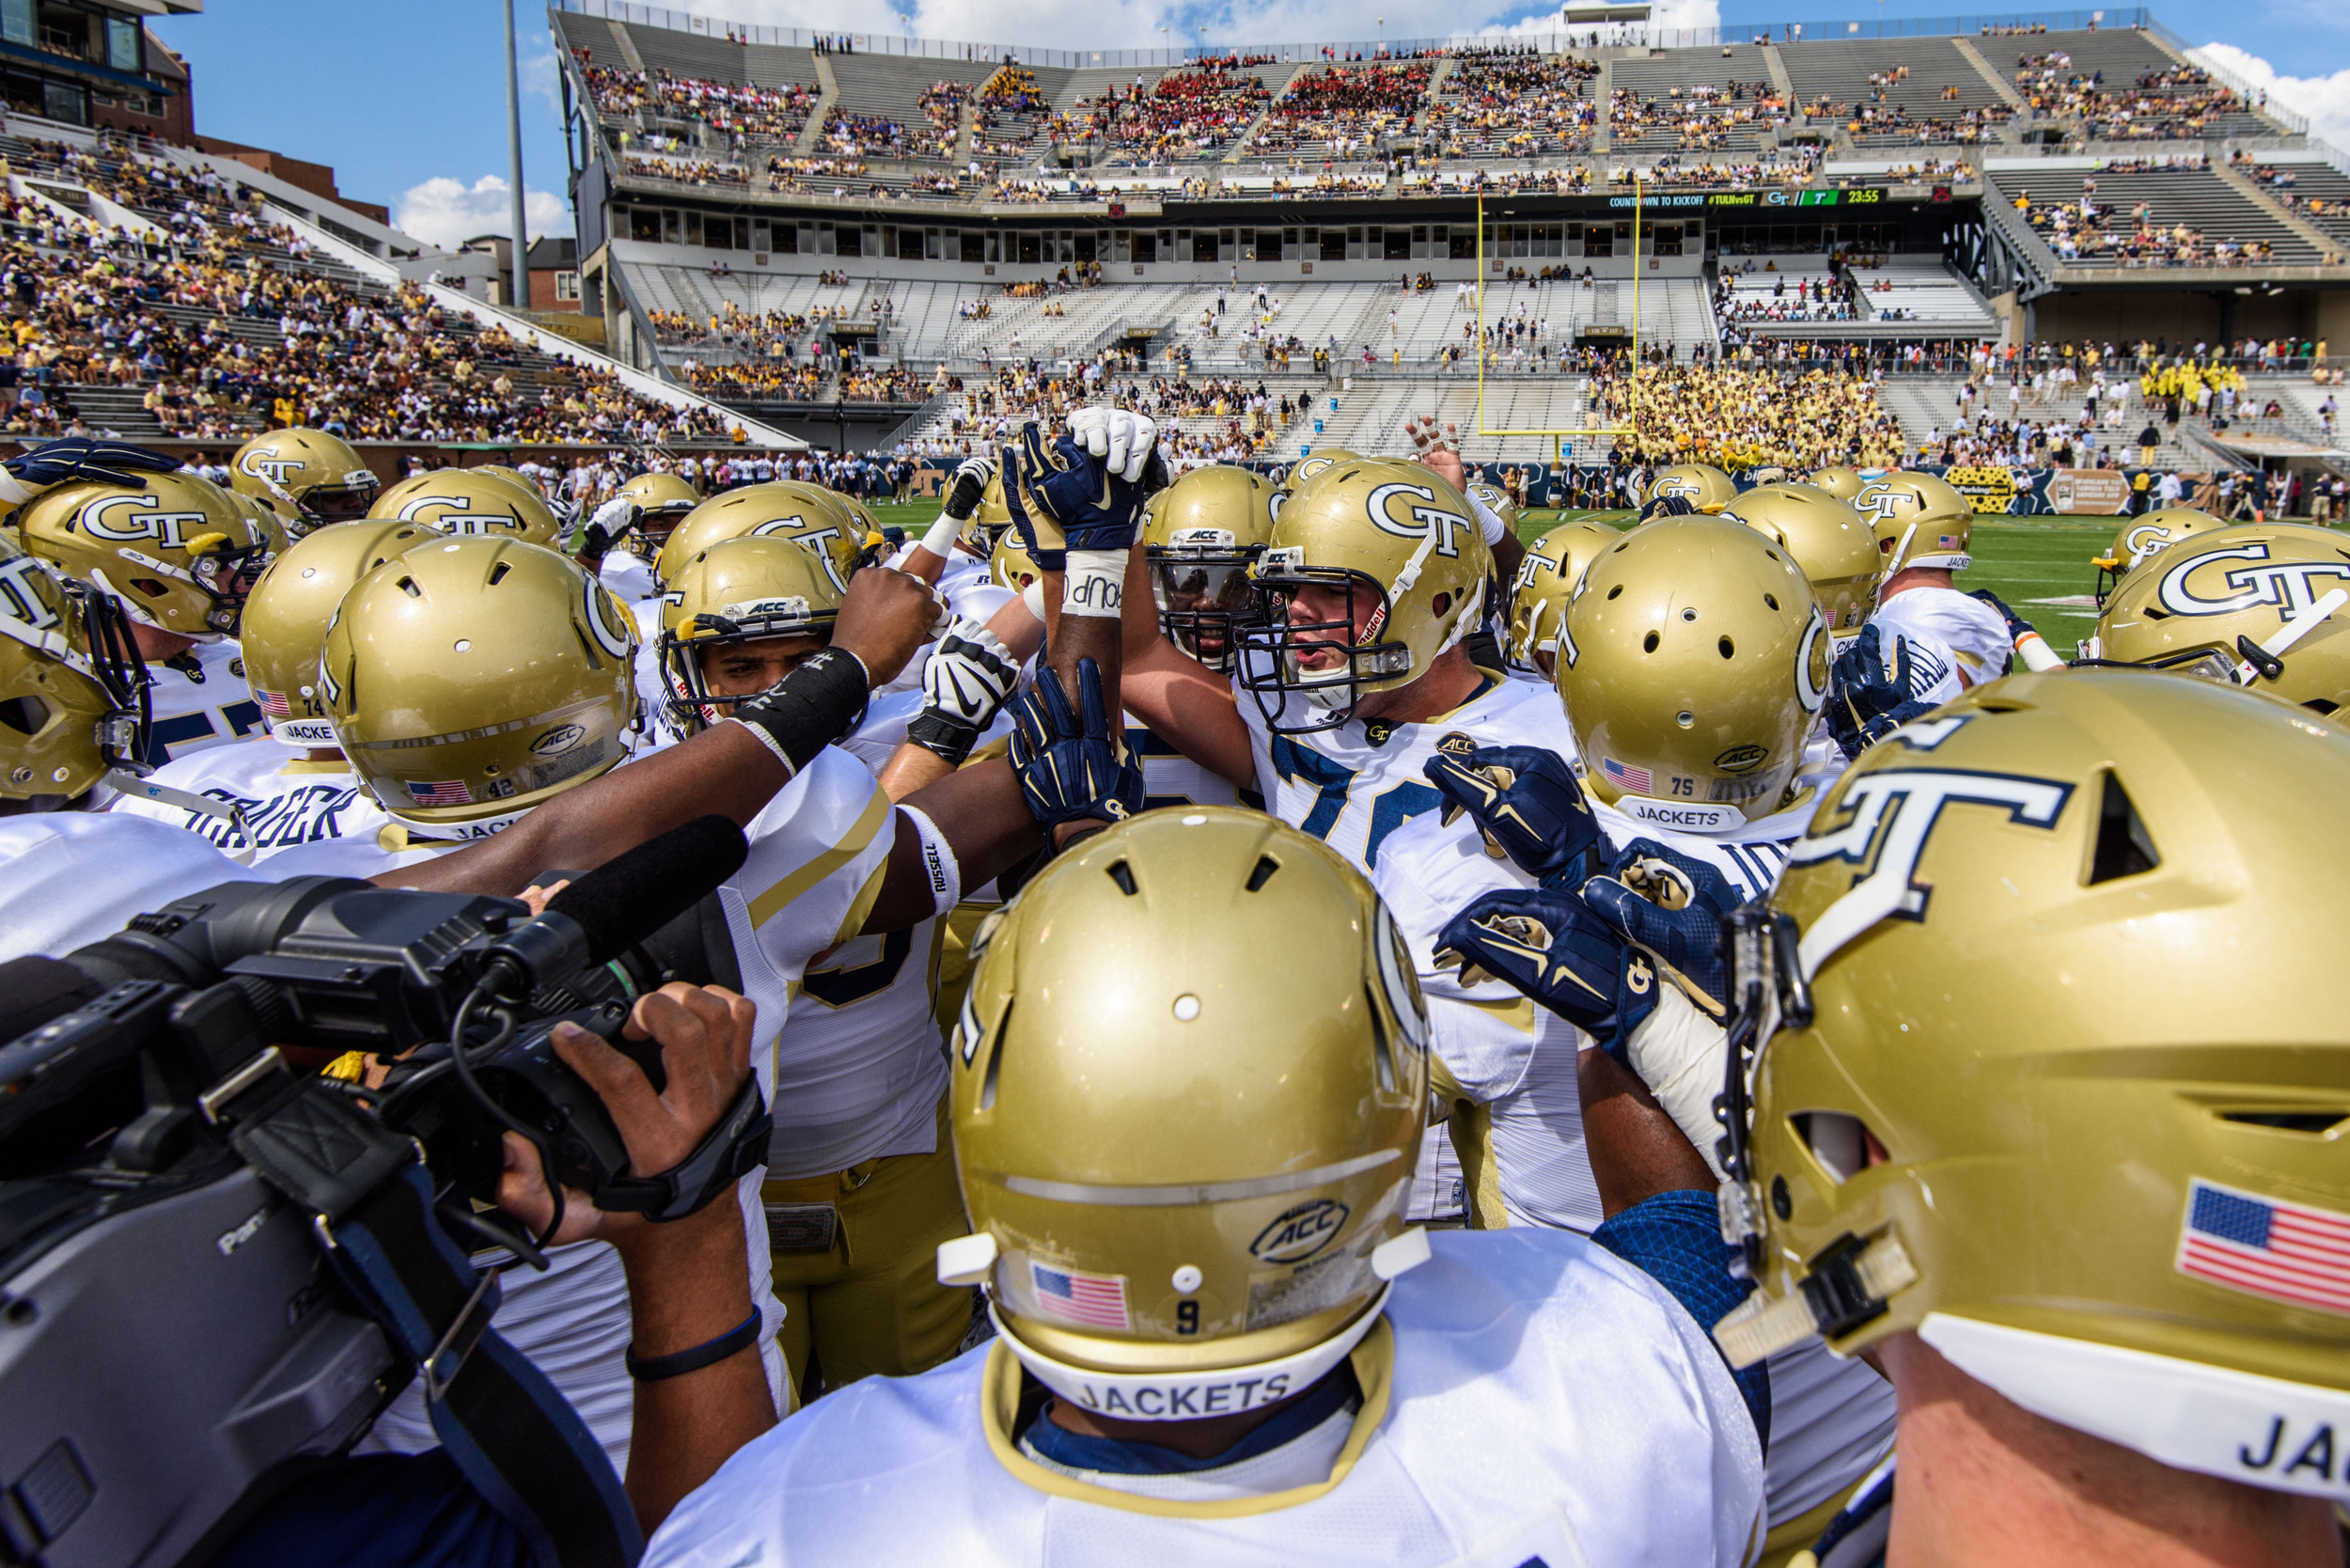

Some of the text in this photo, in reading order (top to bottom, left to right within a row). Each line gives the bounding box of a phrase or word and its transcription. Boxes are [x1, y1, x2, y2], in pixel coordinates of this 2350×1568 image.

[1661, 196, 1671, 206] TO
[1673, 196, 1704, 206] KICKOFF
[1708, 194, 1754, 205] #TULNvsGT
[1848, 190, 1879, 203] 23:55
[1934, 187, 1950, 202] 25
[1109, 204, 1123, 218] 25
[240, 447, 306, 485] GT
[1854, 483, 1913, 518] GT
[83, 495, 208, 549] GT
[1366, 482, 1472, 558] GT
[1188, 530, 1219, 540] ACC
[2158, 544, 2350, 622] GT
[747, 602, 787, 615] ACC
[303, 698, 324, 716] 74
[287, 726, 333, 740] JACKE
[539, 727, 577, 749] ACC
[1369, 725, 1389, 741] GT
[555, 744, 588, 760] WARNING
[1440, 738, 1473, 751] ACC
[1722, 749, 1761, 764] ACC
[488, 778, 514, 798] 42
[1671, 777, 1694, 796] 75
[1637, 806, 1719, 825] JACKETS
[925, 843, 947, 893] RUSSELL
[1627, 956, 1654, 994] GT
[1267, 1206, 1336, 1250] ACC
[1176, 1299, 1200, 1335] 9
[1079, 1373, 1292, 1417] JACKETS
